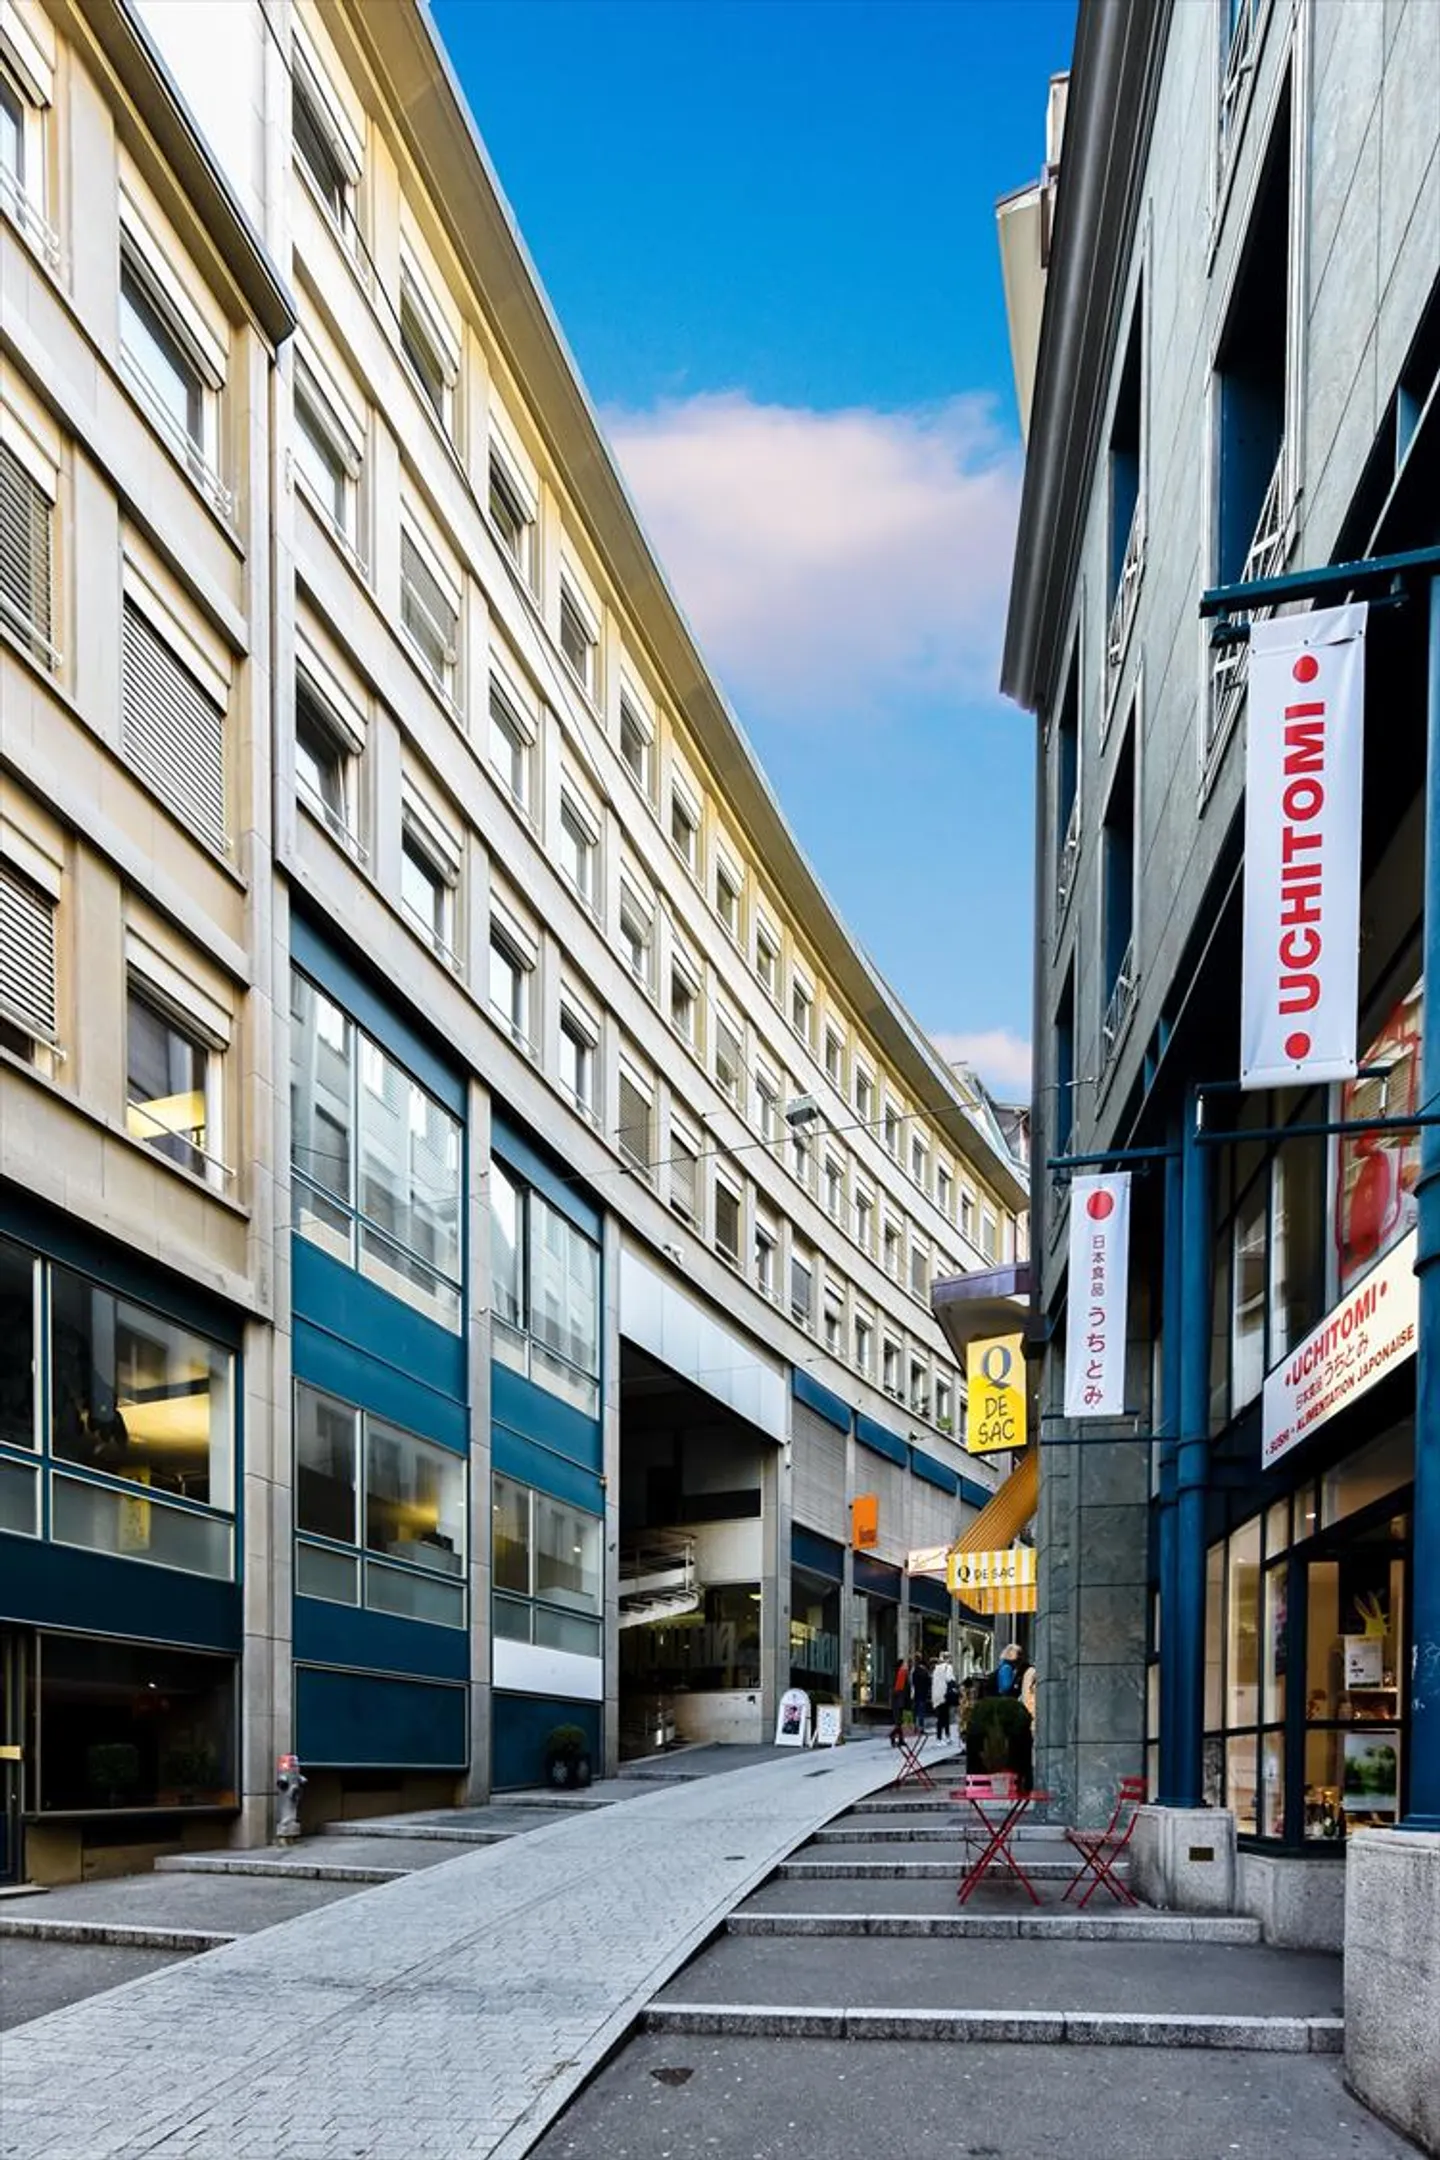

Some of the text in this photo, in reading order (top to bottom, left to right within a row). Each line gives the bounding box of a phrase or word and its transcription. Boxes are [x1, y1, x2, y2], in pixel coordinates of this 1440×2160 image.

[1279, 701, 1325, 1015] UCHITOMI
[983, 1345, 1012, 1390] Q
[1083, 1306, 1106, 1406] うちとみ
[1292, 1284, 1377, 1386] UCHITOMI
[985, 1394, 1008, 1420] DE
[1296, 1373, 1355, 1433] ALIMENTATION
[1357, 1323, 1415, 1383] JAPONAISE
[978, 1418, 1015, 1445] SAC
[957, 1565, 1015, 1583] Q DE SAC
